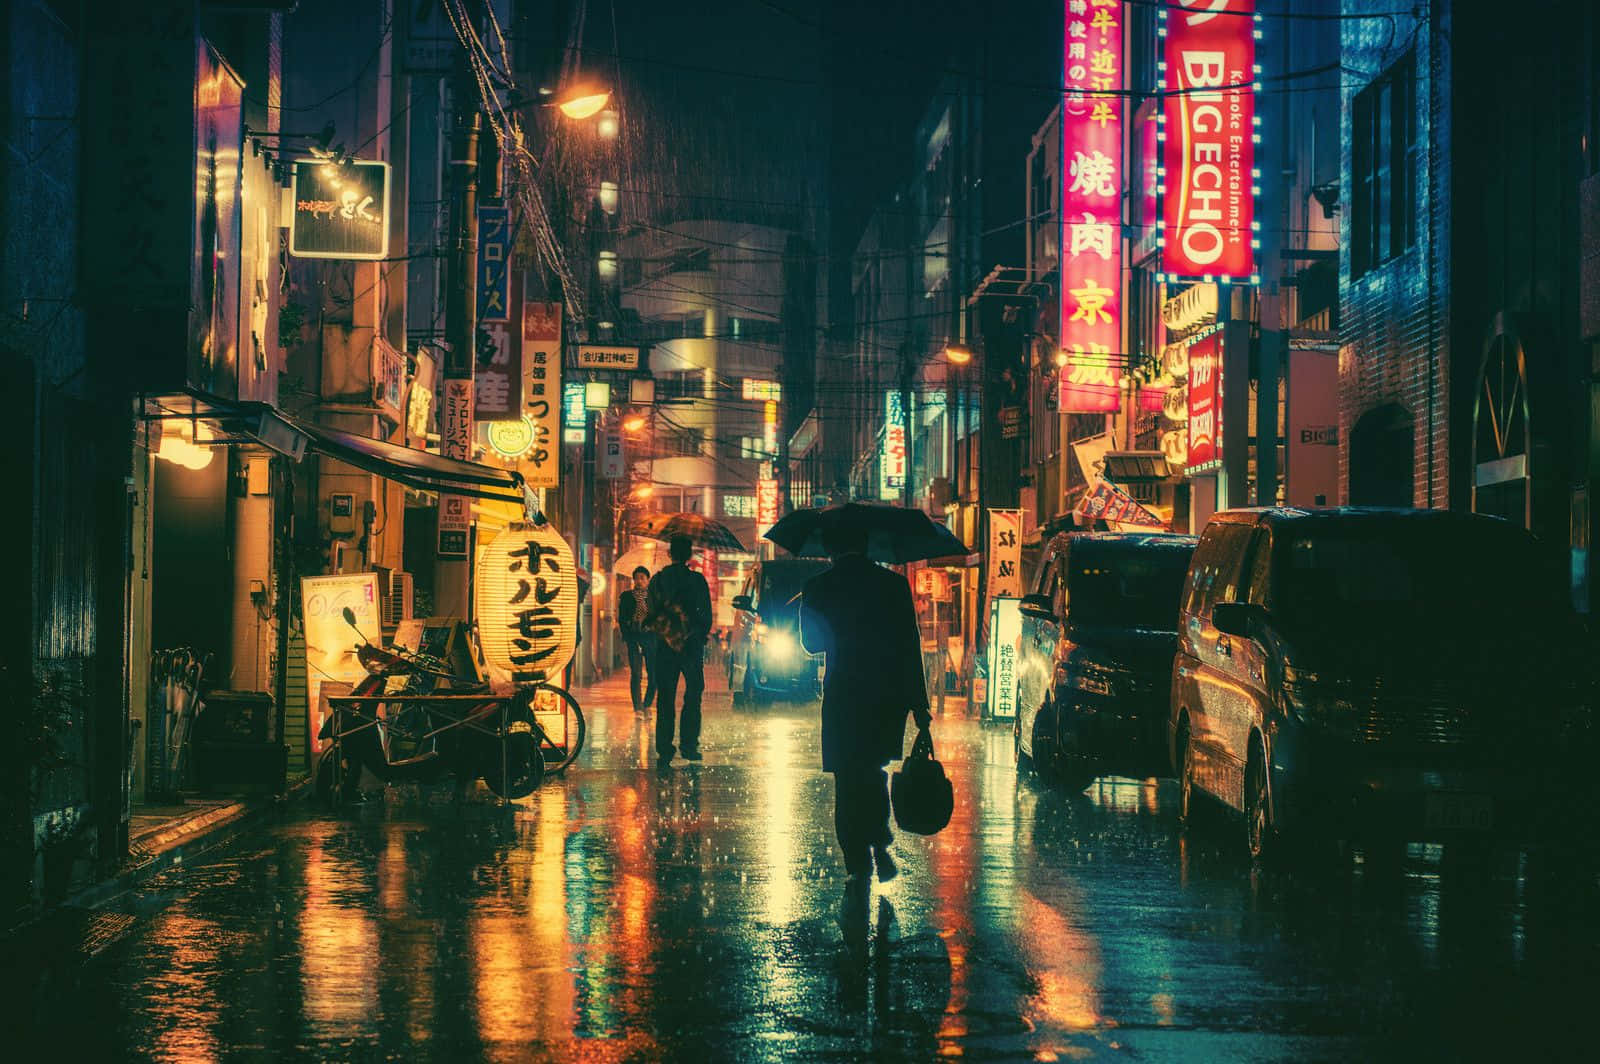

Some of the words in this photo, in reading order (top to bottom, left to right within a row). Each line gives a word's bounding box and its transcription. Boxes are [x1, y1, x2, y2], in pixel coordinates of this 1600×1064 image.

[1181, 51, 1225, 134] BIG
[1228, 70, 1243, 129] Karaoke
[1181, 142, 1224, 266] ECHO
[1228, 135, 1243, 243] Entertainment
[507, 540, 563, 666] ホルモン
[998, 643, 1014, 715] 絶賛営業中
